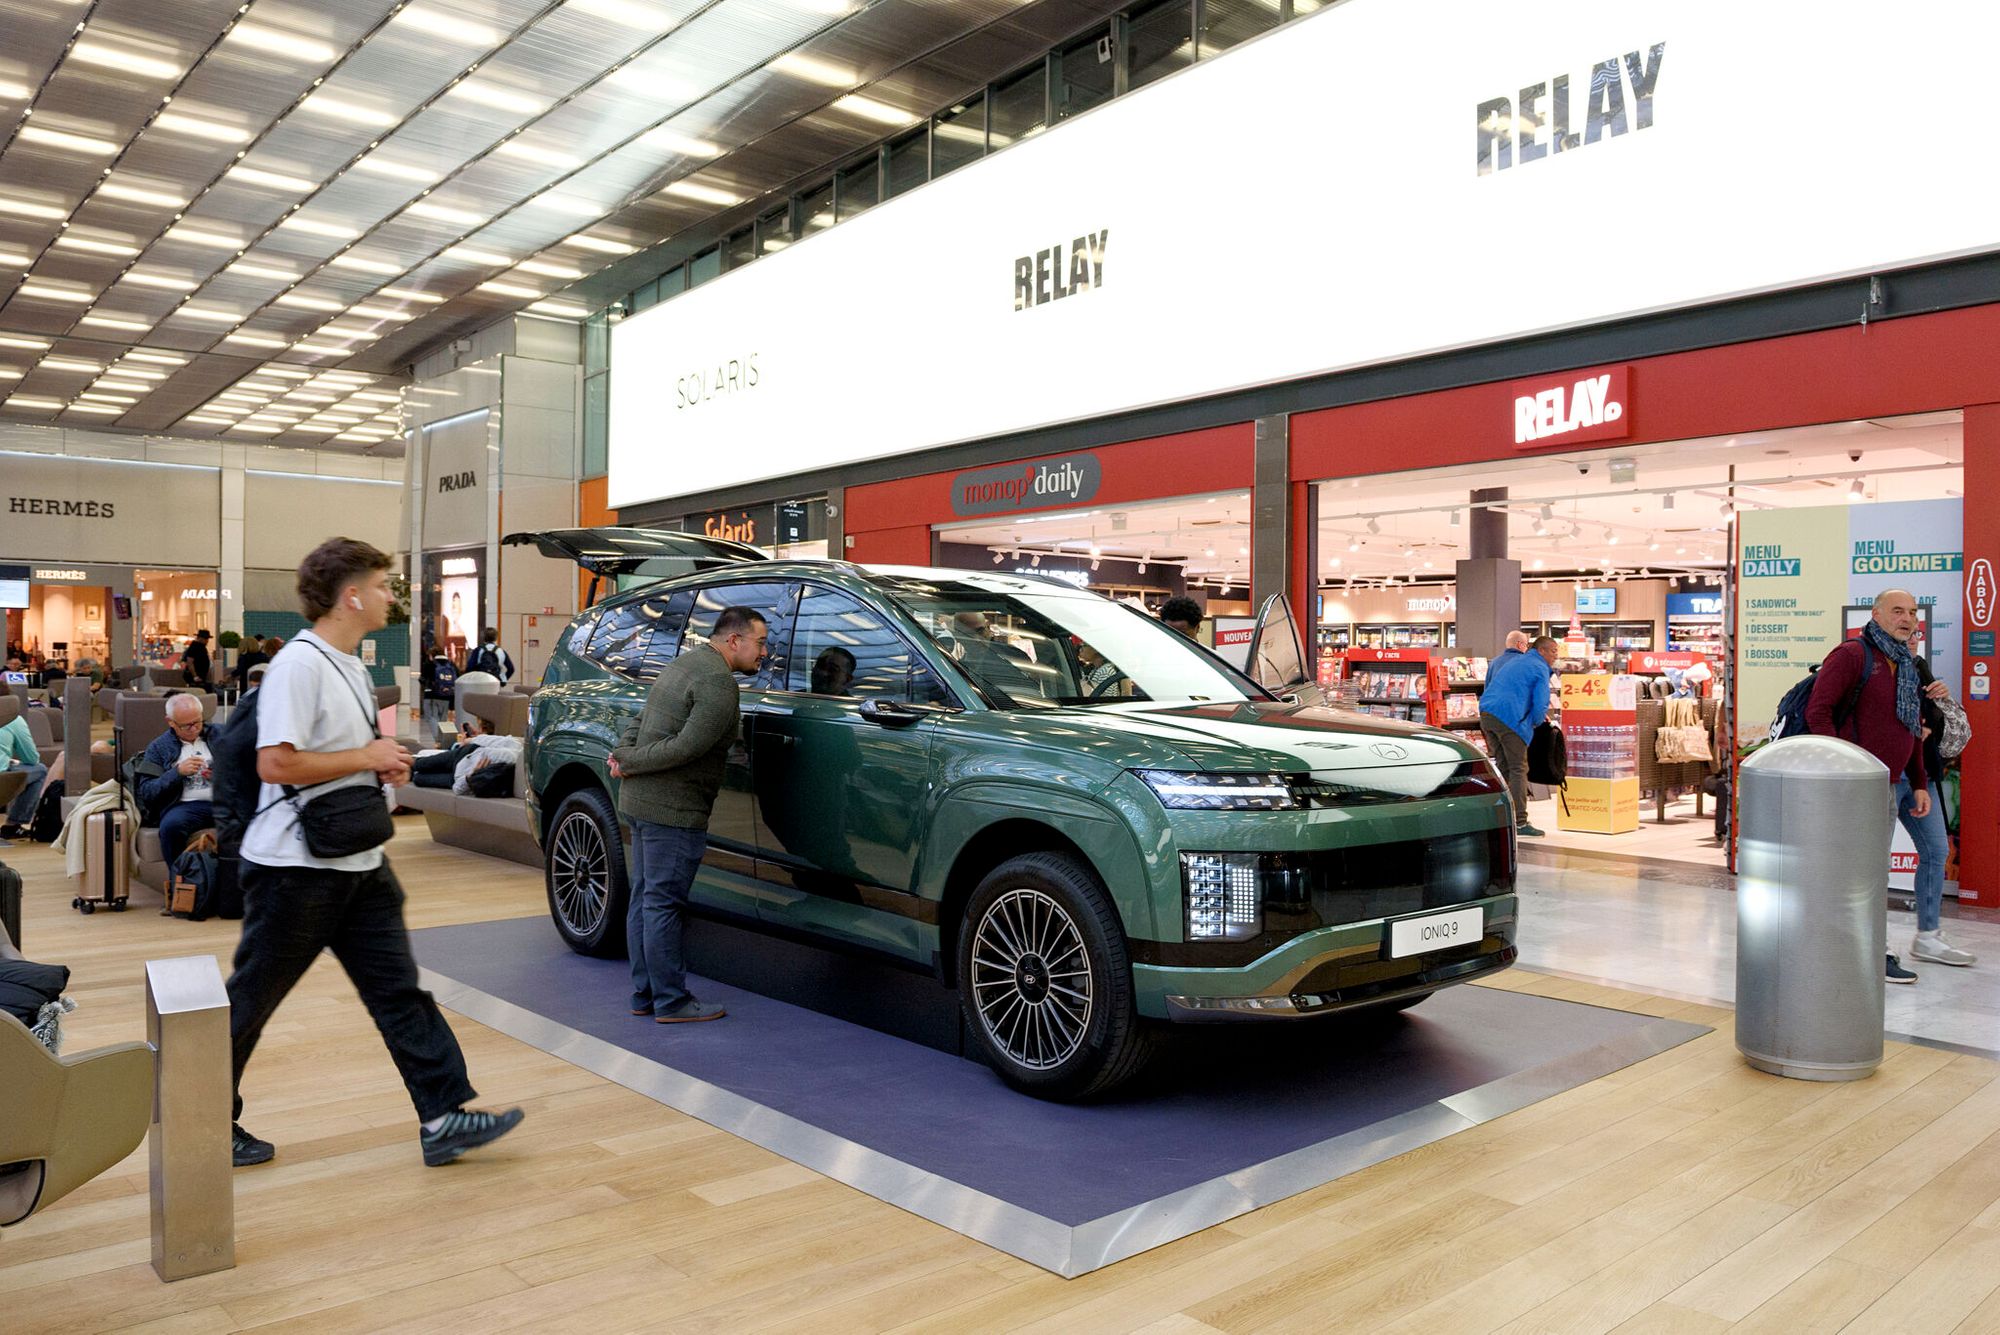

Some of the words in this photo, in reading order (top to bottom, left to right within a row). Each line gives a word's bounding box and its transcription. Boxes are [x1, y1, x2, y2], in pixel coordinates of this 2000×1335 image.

[1477, 40, 1666, 177] RELAY
[1014, 228, 1108, 312] RELAY
[677, 352, 759, 409] SOLARIS
[439, 470, 476, 493] PRADA
[9, 497, 114, 518] HERMÈS
[1745, 545, 1781, 559] MENU
[1855, 540, 1895, 555] MENU
[1976, 565, 1987, 620] TABAC
[1745, 600, 1750, 608] 1
[1751, 599, 1797, 608] SANDWICH
[1745, 624, 1749, 633] 1
[1750, 624, 1788, 633] DESSERT
[1745, 650, 1749, 658] 1
[1750, 649, 1788, 659] BOISSON
[1421, 923, 1450, 941] IONIQ
[1452, 921, 1458, 935] 9
